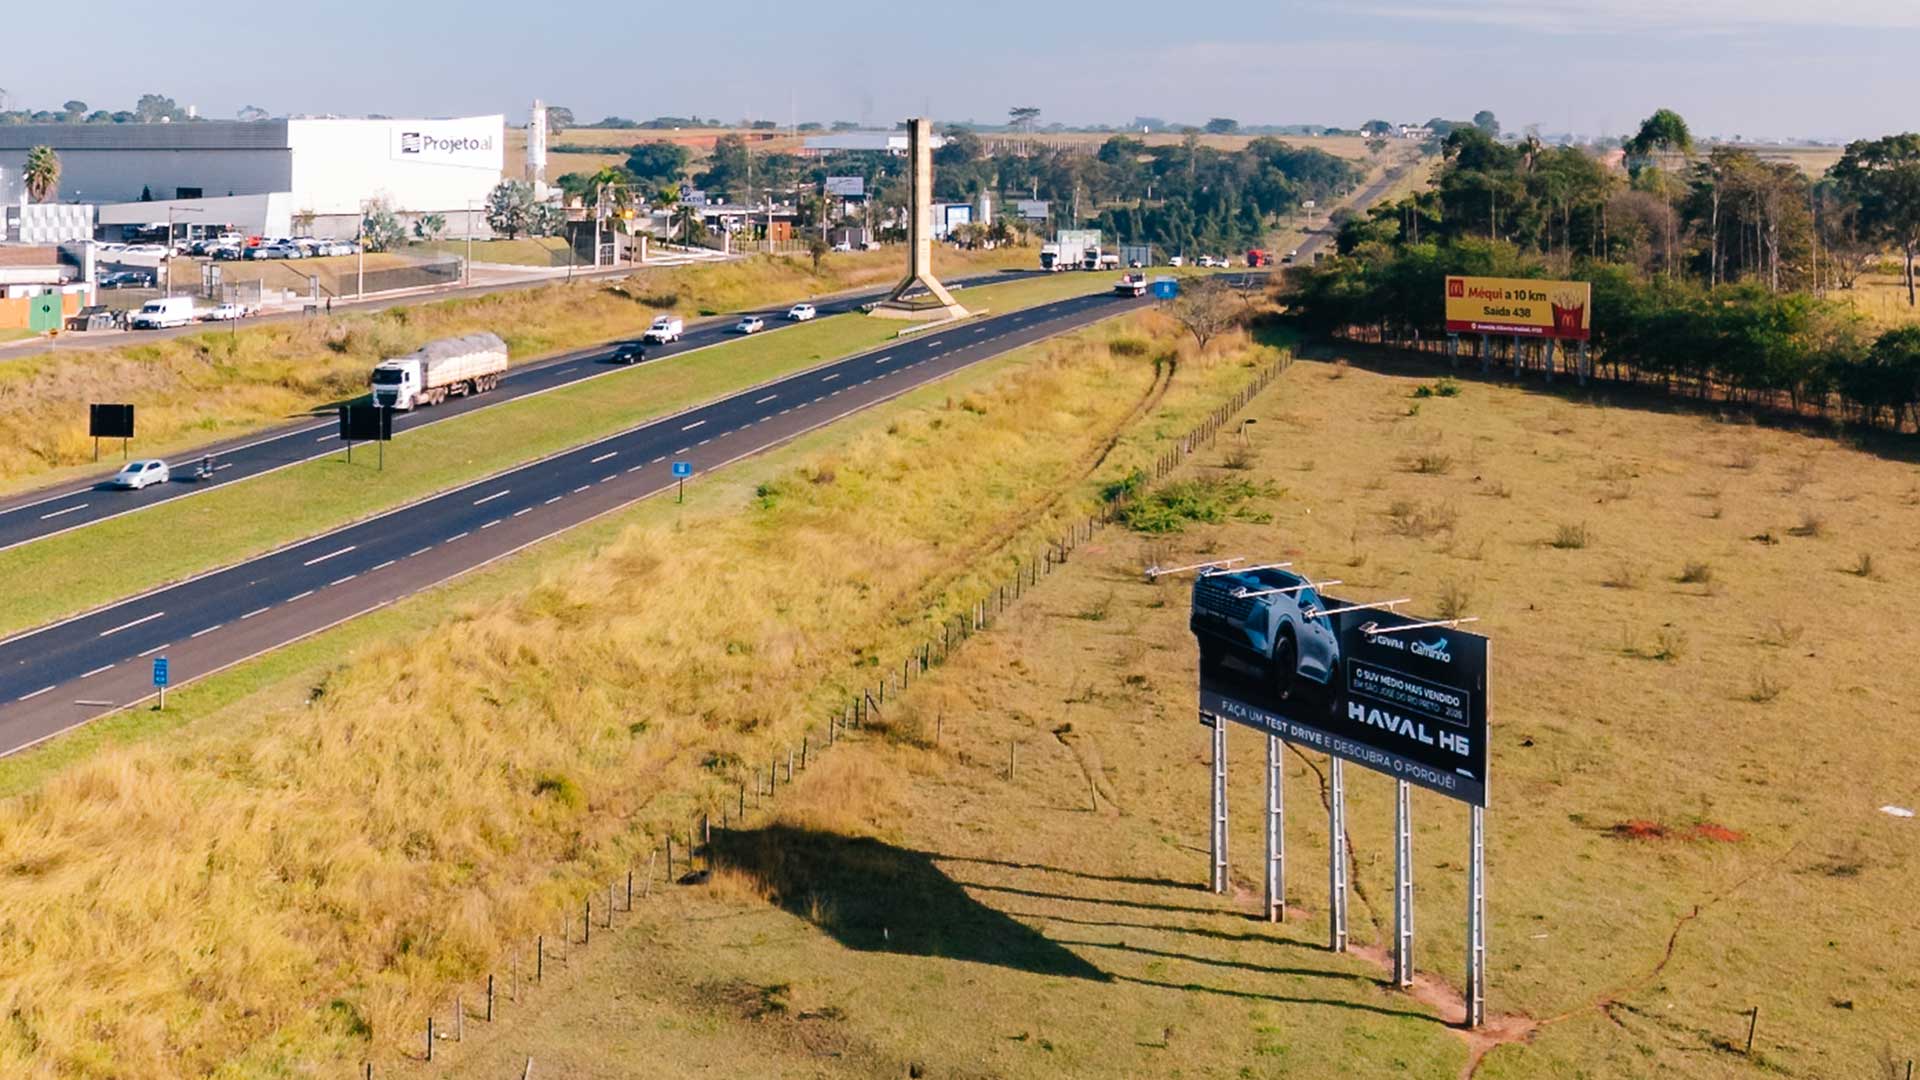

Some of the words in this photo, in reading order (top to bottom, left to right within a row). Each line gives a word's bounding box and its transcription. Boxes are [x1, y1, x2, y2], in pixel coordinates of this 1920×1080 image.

[423, 134, 493, 155] Projetoal
[1468, 286, 1503, 301] Méqui
[1505, 291, 1512, 300] a
[1514, 290, 1527, 300] 10
[1528, 290, 1547, 301] km
[1483, 306, 1511, 317] Saída
[1512, 307, 1531, 318] 438
[1410, 641, 1452, 663] Caminho
[1356, 668, 1363, 679] O
[1363, 670, 1380, 682] SUV
[1380, 674, 1404, 690] MÉDIO
[1404, 682, 1423, 696] MAIS
[1423, 688, 1460, 707] VENDIDO
[1348, 701, 1434, 745] HAVAL
[1439, 730, 1470, 756] H6
[1222, 701, 1247, 717] FAÇA
[1248, 709, 1263, 723] UM
[1264, 715, 1289, 733] TEST
[1290, 725, 1322, 745] DRIVE
[1324, 736, 1332, 748] E
[1333, 739, 1391, 768] DESCUBRA
[1393, 759, 1403, 771] O
[1405, 763, 1456, 790] PORQUÊ!
